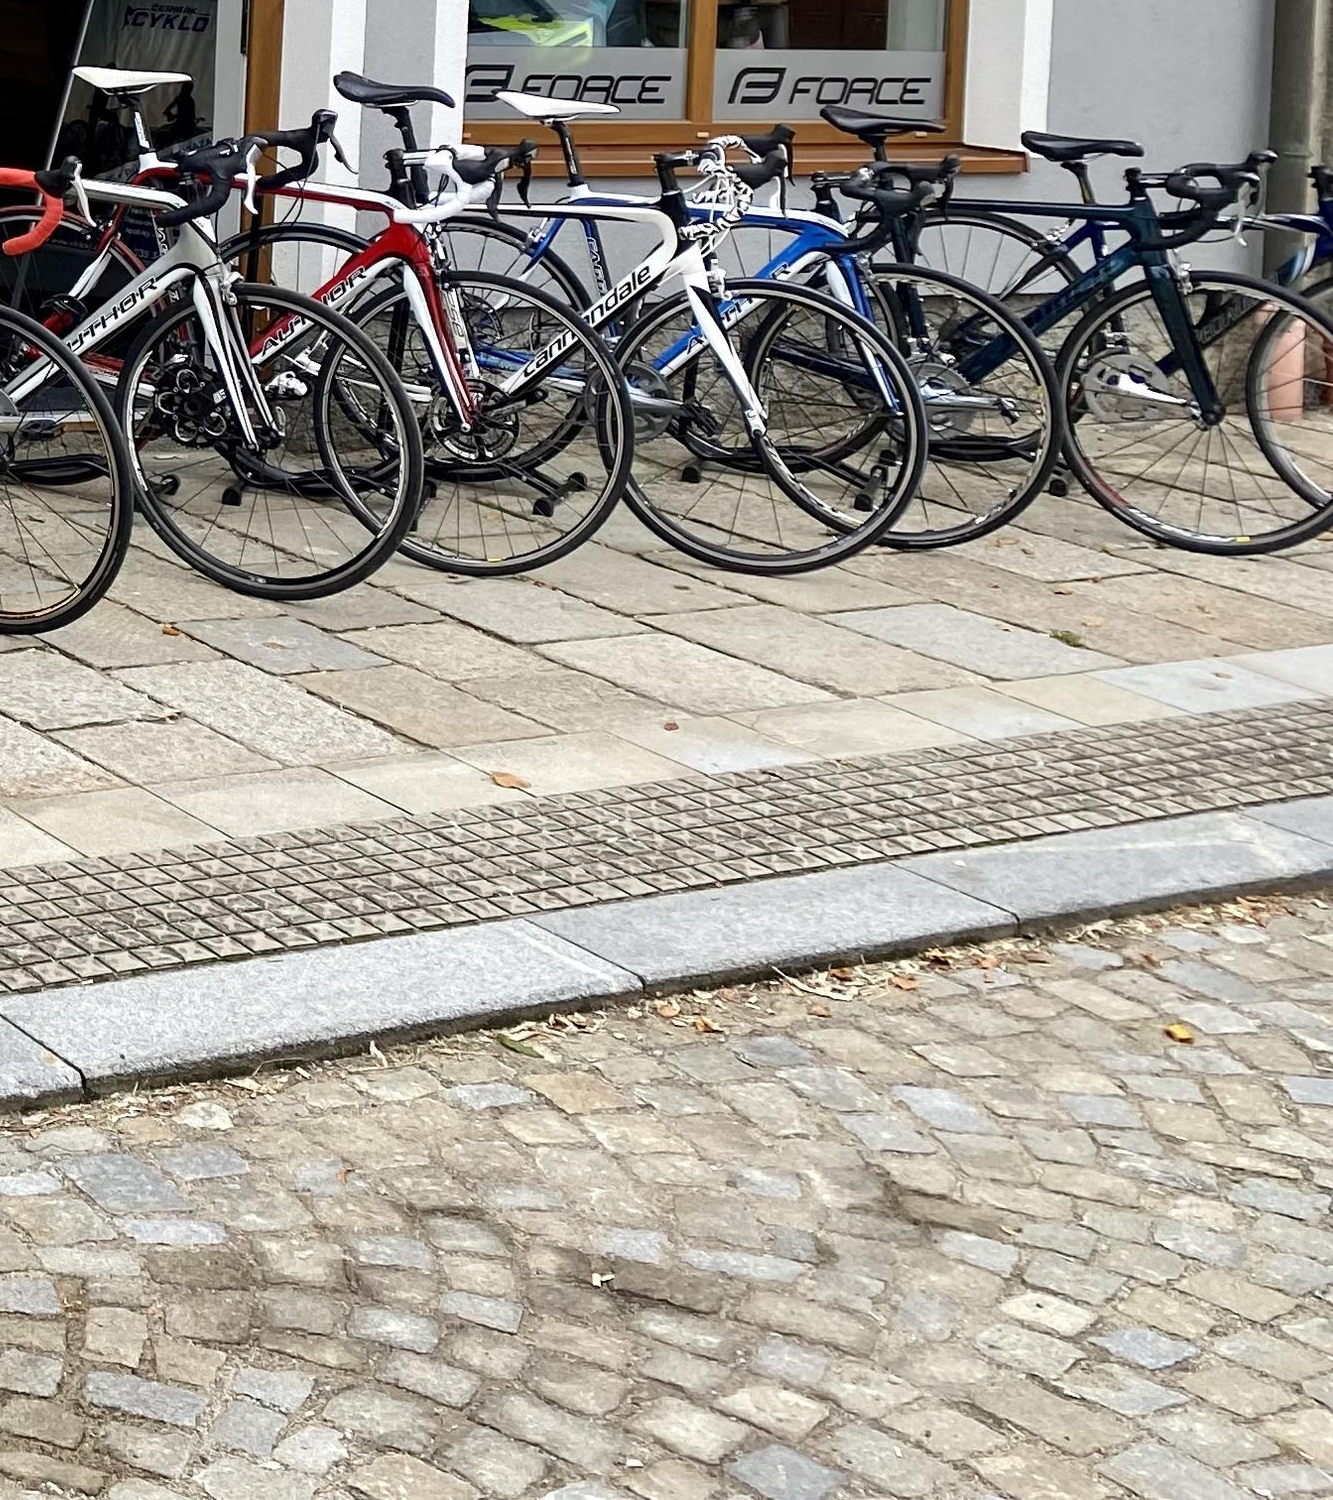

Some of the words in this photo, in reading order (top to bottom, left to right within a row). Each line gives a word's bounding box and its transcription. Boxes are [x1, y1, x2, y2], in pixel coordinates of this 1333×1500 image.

[131, 11, 210, 32] CYKLO
[788, 76, 933, 106] FORCE
[51, 277, 157, 364] UTHOR
[262, 266, 367, 357] AUTOR
[524, 265, 651, 378] cannndale
